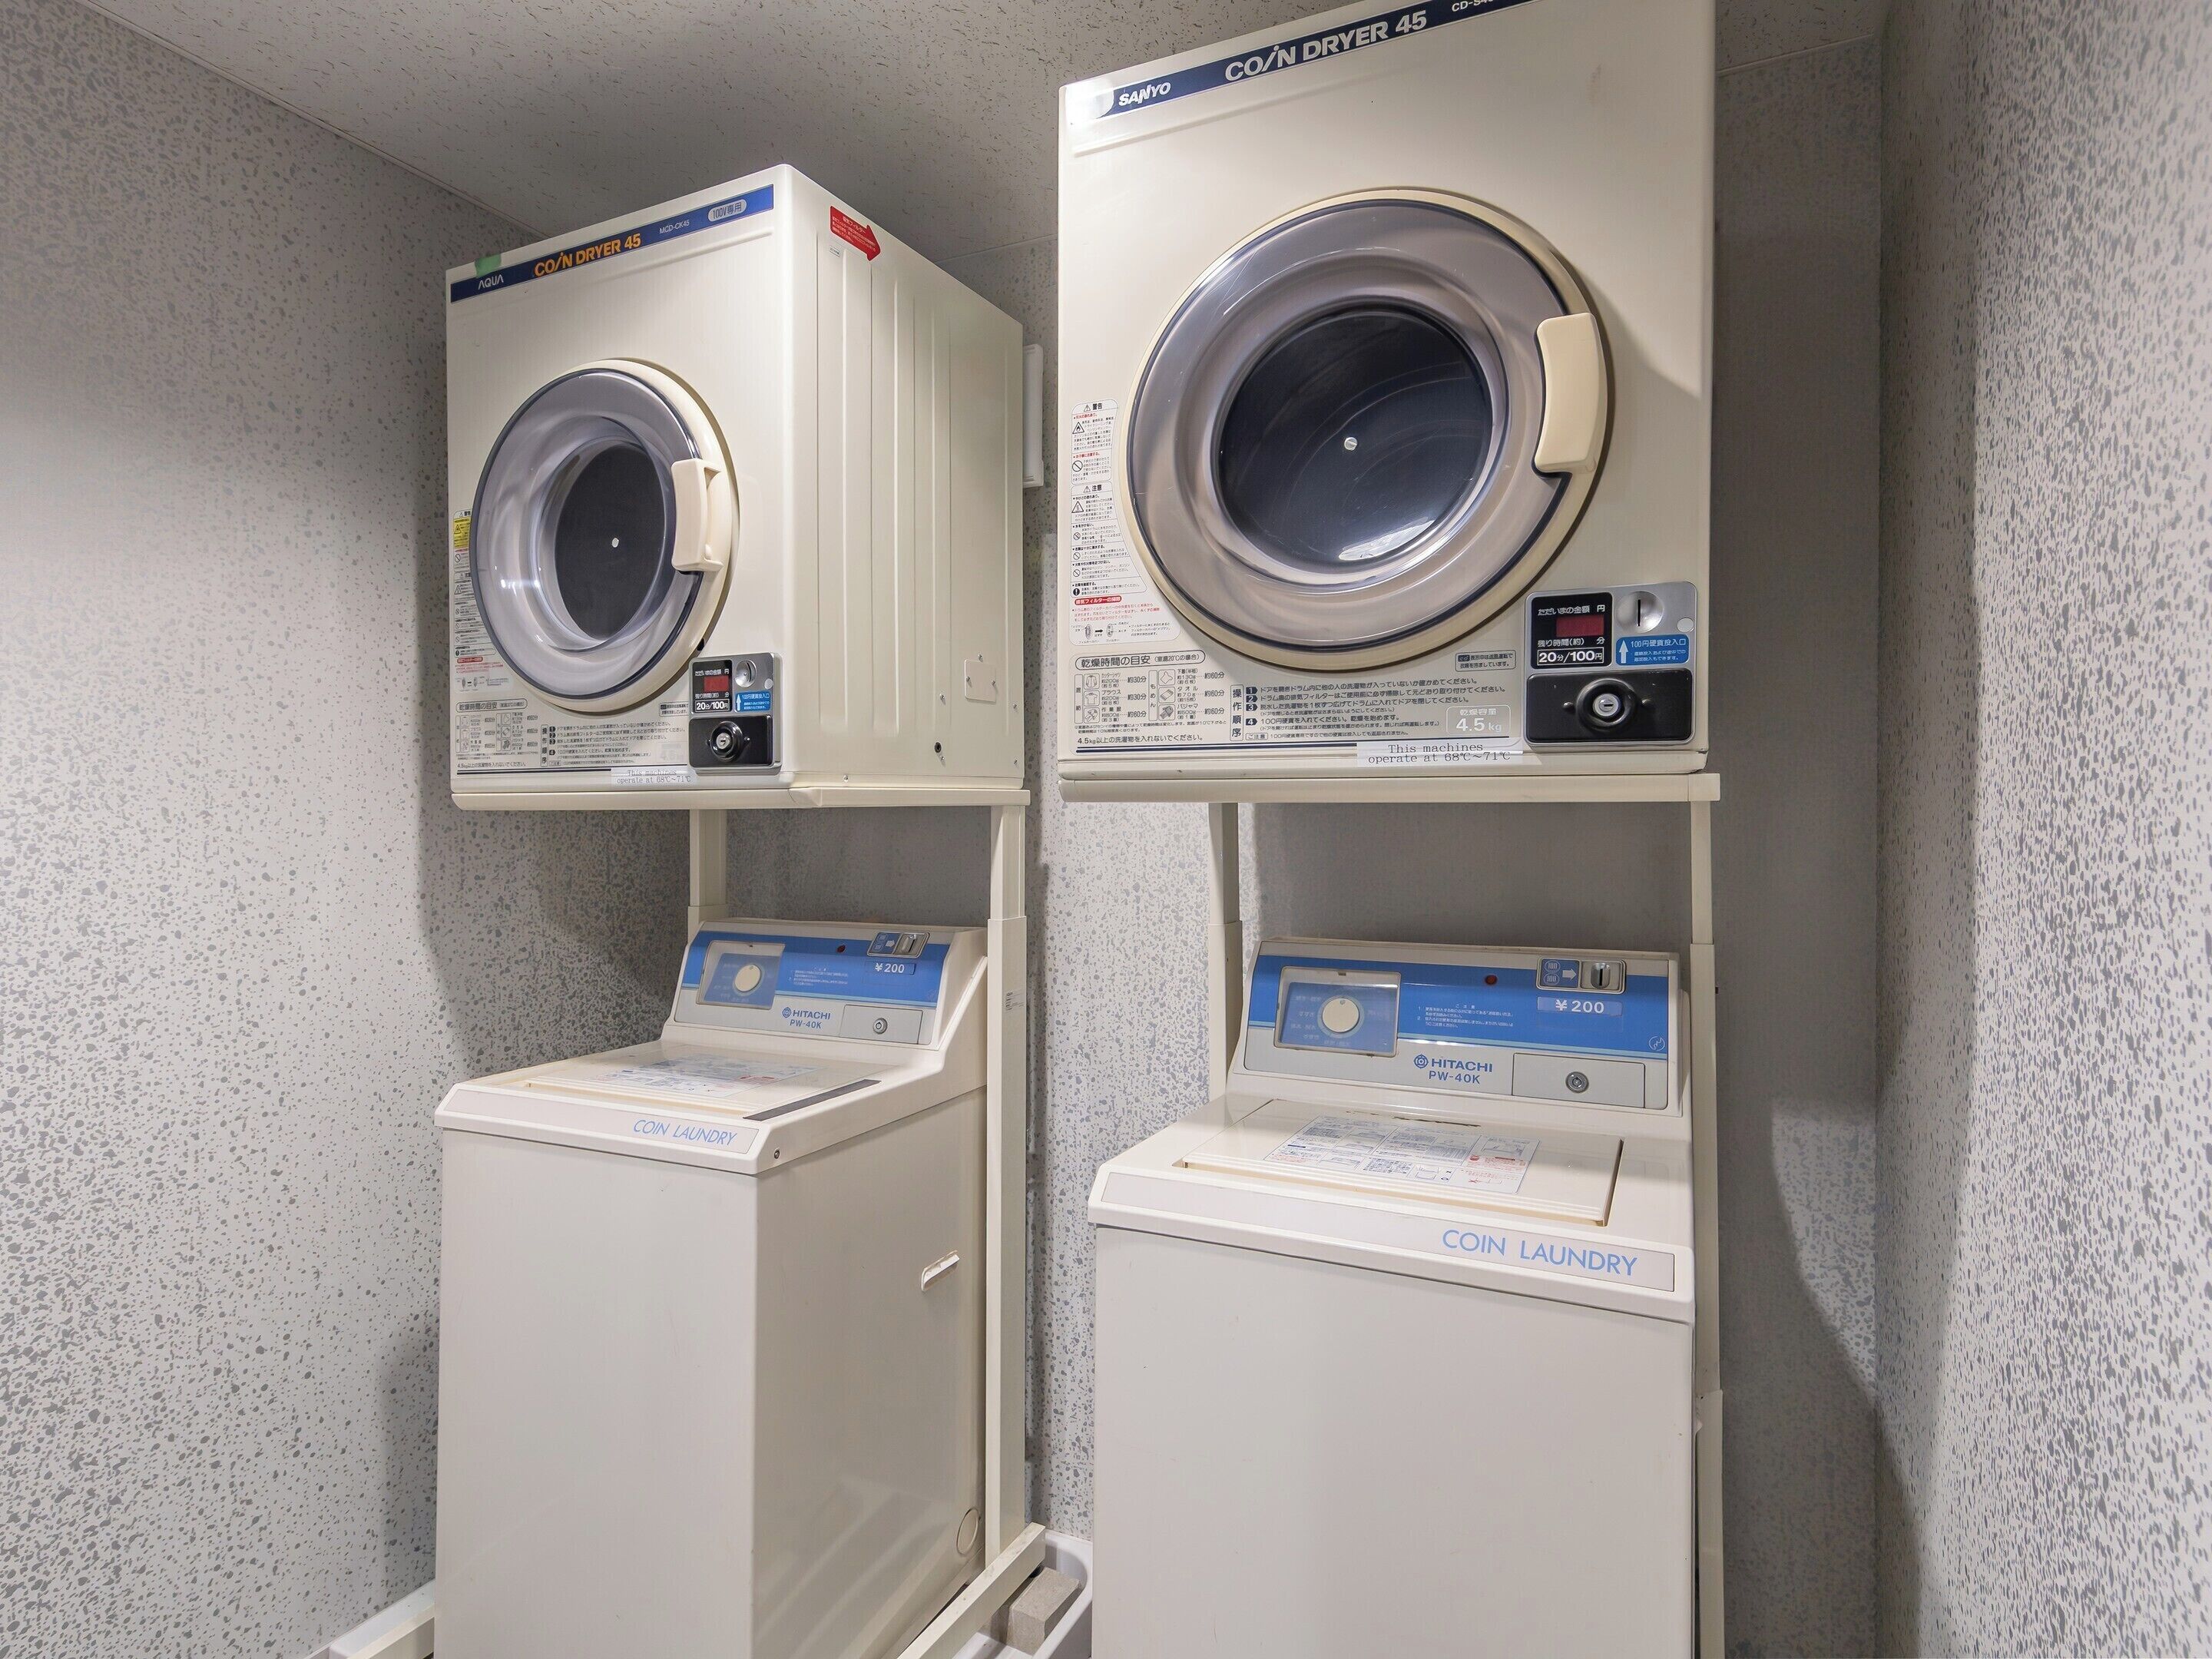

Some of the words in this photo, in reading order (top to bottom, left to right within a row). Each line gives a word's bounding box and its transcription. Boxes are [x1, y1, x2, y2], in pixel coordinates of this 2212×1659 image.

[1225, 45, 1296, 81] COIN
[1303, 21, 1389, 62] DRYER
[1395, 9, 1427, 35] 45
[1118, 81, 1171, 106] SANYO
[713, 201, 742, 219] 100V専用
[659, 219, 690, 234] MCD-CK45
[534, 252, 573, 278] COIN
[576, 239, 621, 265] DRYER
[624, 233, 641, 249] 45
[478, 274, 504, 290] AQUA
[1631, 639, 1687, 648] 100円硬貨投入口
[1081, 655, 1151, 668] 乾燥時間の目安
[1538, 651, 1602, 663] 20分/100円
[1232, 688, 1242, 738] 操作順序
[1459, 707, 1497, 716] 乾燥容量
[1455, 717, 1485, 732] 4.5
[1488, 723, 1502, 732] kg
[1388, 744, 1416, 753] This
[1423, 743, 1483, 753] machines
[1368, 754, 1417, 764] operate
[1424, 753, 1438, 762] at
[793, 1010, 830, 1019] HITACHI
[790, 1019, 822, 1028] PW-40K
[1431, 1058, 1493, 1072] HITACHI
[1429, 1071, 1480, 1084] PW-40K
[633, 1119, 671, 1134] COIN
[672, 1124, 737, 1146] LAUNDRY
[1442, 1230, 1506, 1257] COIN
[1519, 1240, 1637, 1277] LAUNDRY
